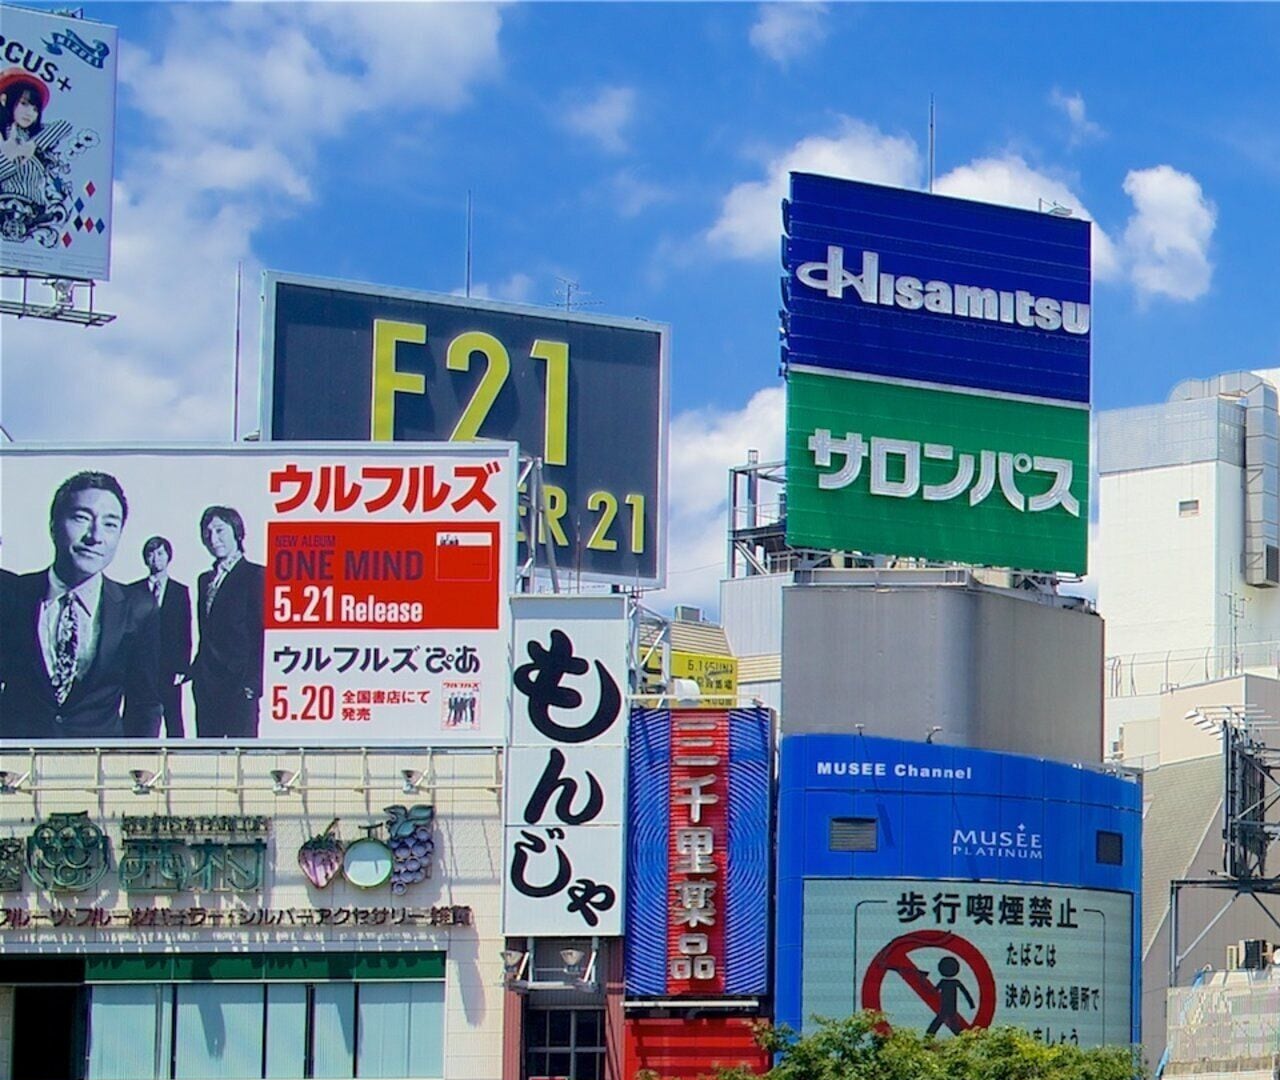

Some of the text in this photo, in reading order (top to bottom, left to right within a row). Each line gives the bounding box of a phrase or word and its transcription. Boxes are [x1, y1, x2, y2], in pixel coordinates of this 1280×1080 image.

[797, 245, 1090, 335] Hisamitsu
[372, 319, 570, 466] F21
[270, 461, 501, 513] ウルフルズ
[808, 428, 1080, 517] サロンパス
[587, 491, 645, 553] 21
[275, 535, 336, 547] NEW ALBUM
[275, 550, 424, 581] ONE MIND
[274, 585, 423, 623] 5.21 Release
[274, 645, 480, 675] ウルフルズぴあ
[272, 685, 430, 721] 5.20 全国書店にて
[342, 707, 371, 721] 発売
[511, 629, 622, 927] もんじゃ
[817, 761, 972, 779] MUSEE Channel
[670, 719, 720, 979] 三千里薬品
[953, 847, 1043, 859] PLATINUM
[897, 892, 1079, 929] 歩行喫煙禁止
[1006, 943, 1056, 968] たばこは
[1006, 984, 1099, 1011] 決められた場所で
